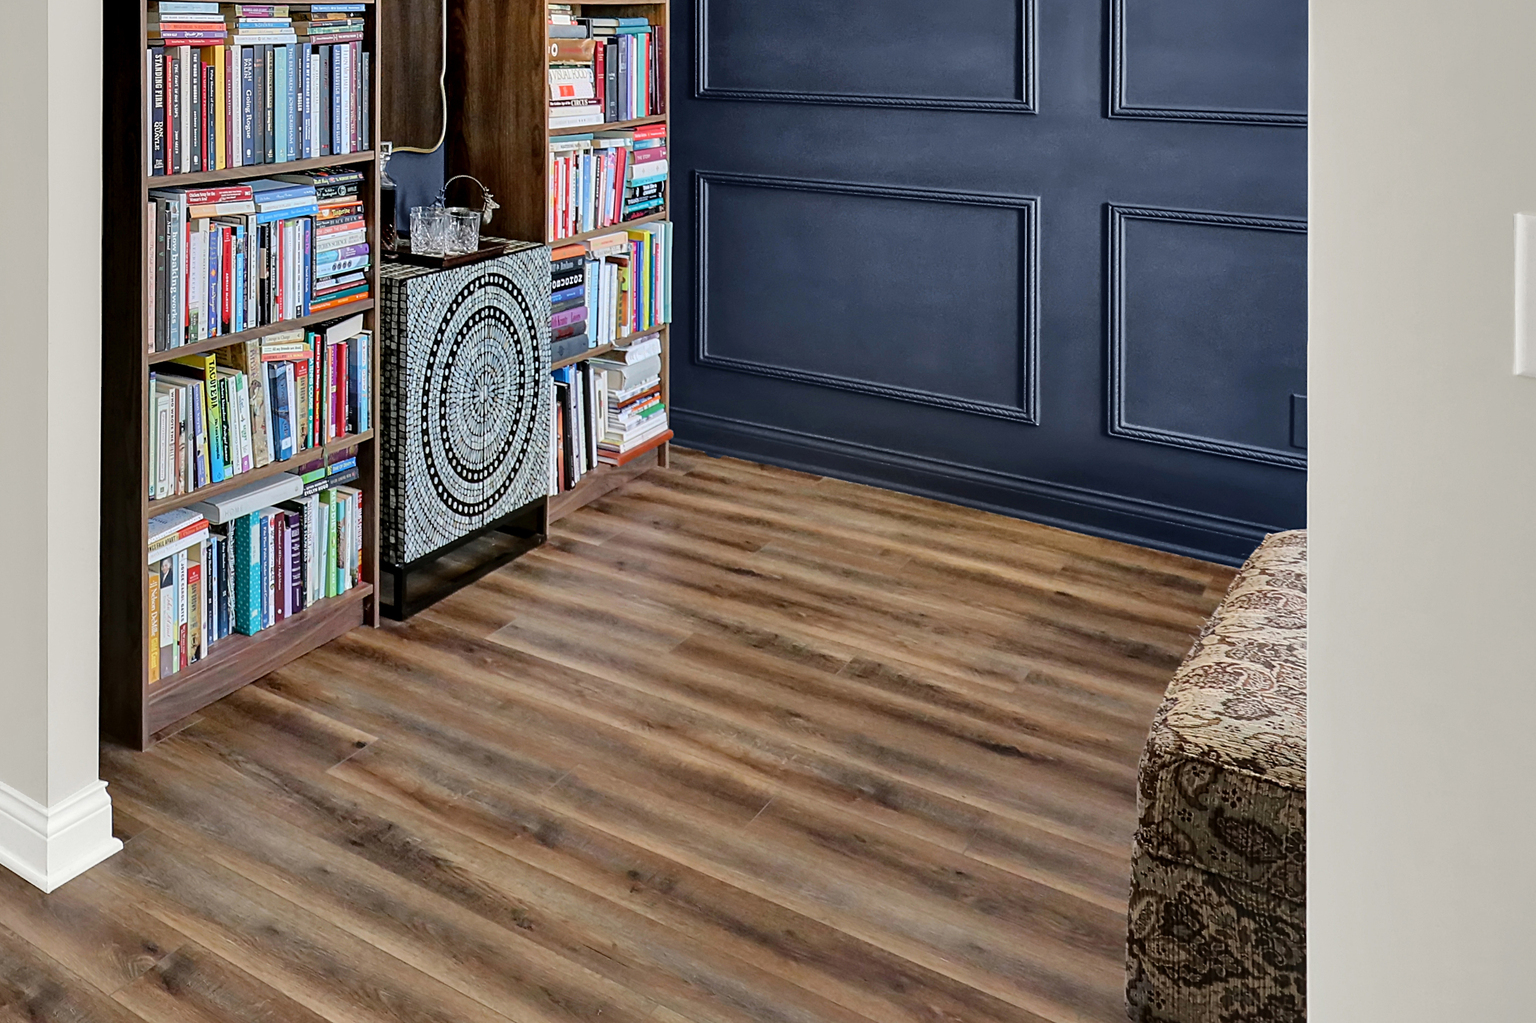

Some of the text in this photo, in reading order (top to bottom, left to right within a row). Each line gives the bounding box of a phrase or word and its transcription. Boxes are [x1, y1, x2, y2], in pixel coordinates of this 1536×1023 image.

[154, 54, 163, 108] STANDING FIRM
[170, 253, 178, 294] baking
[208, 359, 218, 409] TACOPEDIA
[150, 589, 158, 611] Nelson
